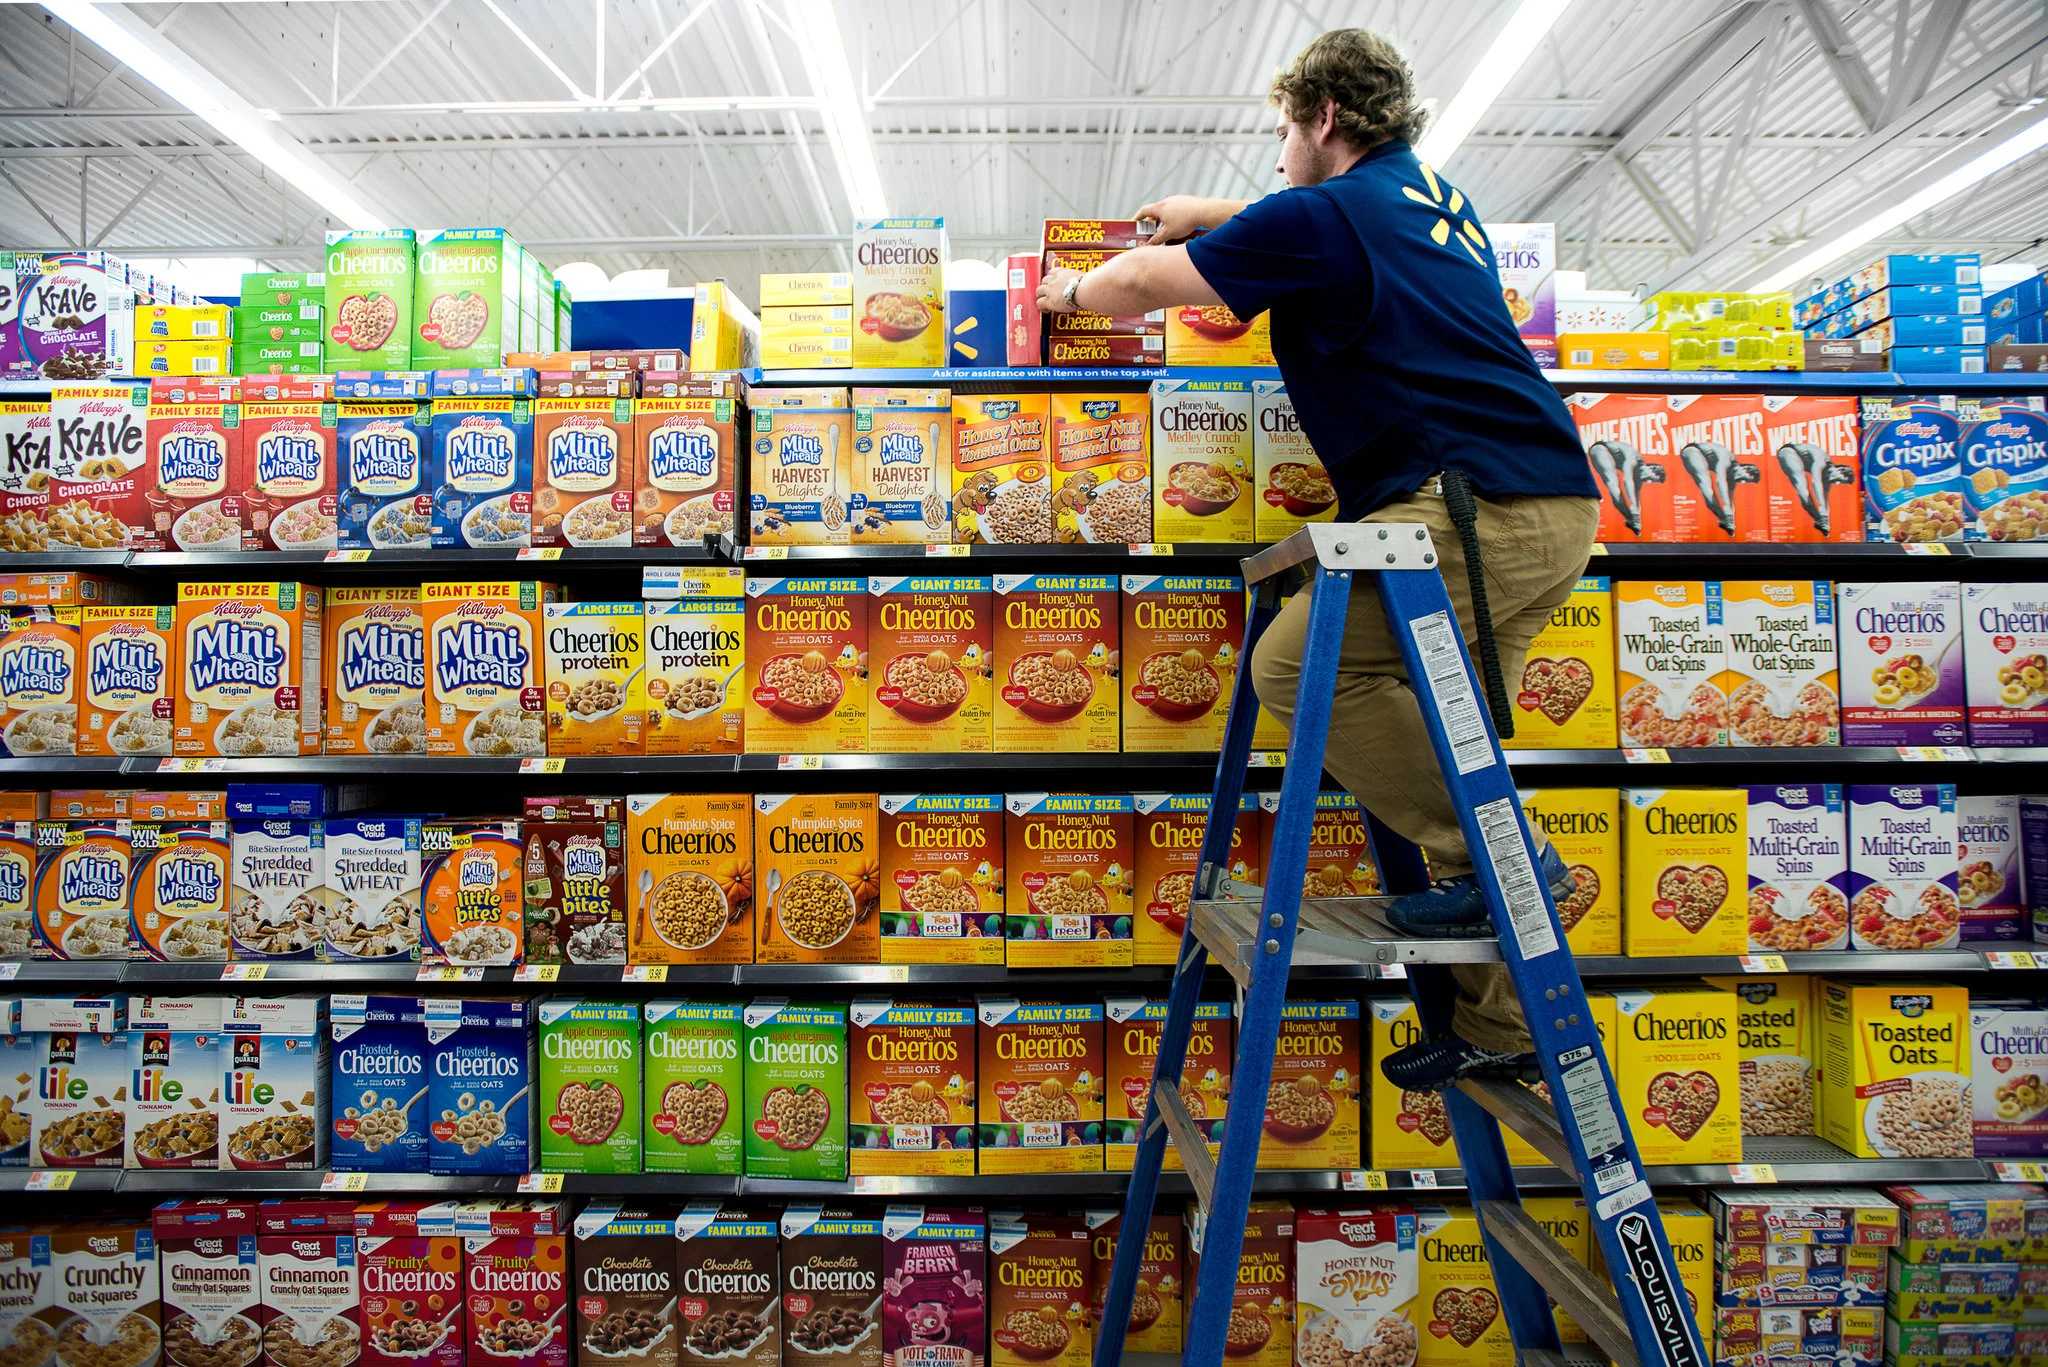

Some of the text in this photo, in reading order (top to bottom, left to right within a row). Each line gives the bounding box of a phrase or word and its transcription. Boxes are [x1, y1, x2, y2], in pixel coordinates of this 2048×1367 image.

[883, 220, 934, 229] FAMILY SIZE
[875, 237, 913, 246] Honey Nut
[858, 243, 938, 266] Cheerios
[16, 258, 41, 268] WIN
[17, 267, 41, 275] GOLD
[864, 265, 932, 277] Medley Crunch
[260, 311, 292, 322] Cheerios
[1056, 313, 1112, 331] Cheerios
[40, 330, 97, 344] CHOCOLATE
[1120, 369, 1139, 378] top
[79, 402, 123, 415] Kellogg's
[438, 401, 509, 410] FAMILY SIZE
[982, 402, 1016, 413] Hospitality
[1178, 401, 1219, 412] Honey Nut
[461, 416, 501, 428] Kellogg's
[1167, 432, 1241, 444] Medley Crunch
[1580, 412, 1668, 456] WHEATIES
[1671, 411, 1763, 456] WHEATIES
[163, 437, 216, 464] Mini
[781, 436, 818, 452] Mini
[960, 438, 1040, 463] Toasted Oats
[781, 450, 821, 465] Wheats
[1876, 437, 1956, 467] Crispix
[162, 461, 219, 482] Wheats
[772, 468, 830, 484] HARVEST
[58, 480, 134, 498] CHOCOLATE
[776, 484, 824, 497] Delights
[683, 581, 711, 590] Cheerios
[1036, 578, 1106, 589] GIANT SIZE
[184, 585, 270, 596] GIANT SIZE
[1654, 585, 1686, 597] Great
[1039, 593, 1093, 605] Honey Nut
[1662, 594, 1688, 603] Value
[456, 604, 505, 618] Kellogg's
[577, 605, 635, 615] LARGE SIZE
[1892, 602, 1944, 612] Multi Grain
[757, 604, 851, 631] Cheerios
[1649, 616, 1699, 633] Toasted
[109, 625, 146, 638] Kellogg's
[194, 620, 277, 659] Mini
[807, 635, 833, 644] OATS
[1624, 635, 1723, 654] Whole-Grain
[561, 654, 629, 673] protein
[1646, 655, 1706, 674] Oat Spins
[192, 657, 277, 688] Wheats
[112, 692, 137, 700] Original
[834, 710, 854, 718] Gluten
[707, 802, 745, 811] Family Size
[1046, 799, 1122, 811] FAMILY SIZE
[663, 818, 735, 831] Pumpkin Spice
[1058, 814, 1110, 827] Honey Nut
[1881, 818, 1930, 834] Toasted
[39, 829, 66, 839] WIN
[1025, 823, 1116, 850] Cheerios
[37, 837, 65, 846] GOLD
[642, 827, 736, 855] Cheerios
[1862, 836, 1951, 856] Multi-Grain
[248, 845, 307, 853] Bite Size Frosted
[242, 854, 313, 875] Shredded
[1889, 858, 1926, 876] Spins
[248, 872, 308, 889] WHEAT
[456, 890, 501, 908] little
[456, 904, 501, 924] bites
[366, 1012, 395, 1021] Cheerios
[669, 1027, 732, 1037] Apple Cinnamon
[1869, 1023, 1953, 1042] Toasted
[360, 1045, 392, 1055] Frosted
[649, 1033, 737, 1059] Cheerios
[1563, 1050, 1581, 1062] 375
[1697, 1053, 1721, 1061] OATS
[1890, 1045, 1938, 1064] Oats
[918, 1228, 975, 1238] FAMILY SIZE
[1339, 1221, 1375, 1234] Great
[1349, 1233, 1376, 1242] Value
[906, 1244, 955, 1259] FRANKEN
[388, 1257, 424, 1272] Fruity
[602, 1257, 653, 1270] Chocolate
[904, 1256, 958, 1274] BERRY
[1029, 1256, 1077, 1268] Honey Nut
[1325, 1256, 1395, 1270] HONEY NUT
[65, 1262, 146, 1288] Crunchy
[172, 1265, 250, 1281] Cinnamon
[363, 1265, 456, 1292] Cheerios
[999, 1262, 1083, 1288] Cheerios
[68, 1290, 138, 1304] Oat Squares
[903, 1347, 964, 1360] VOTE FRANK
